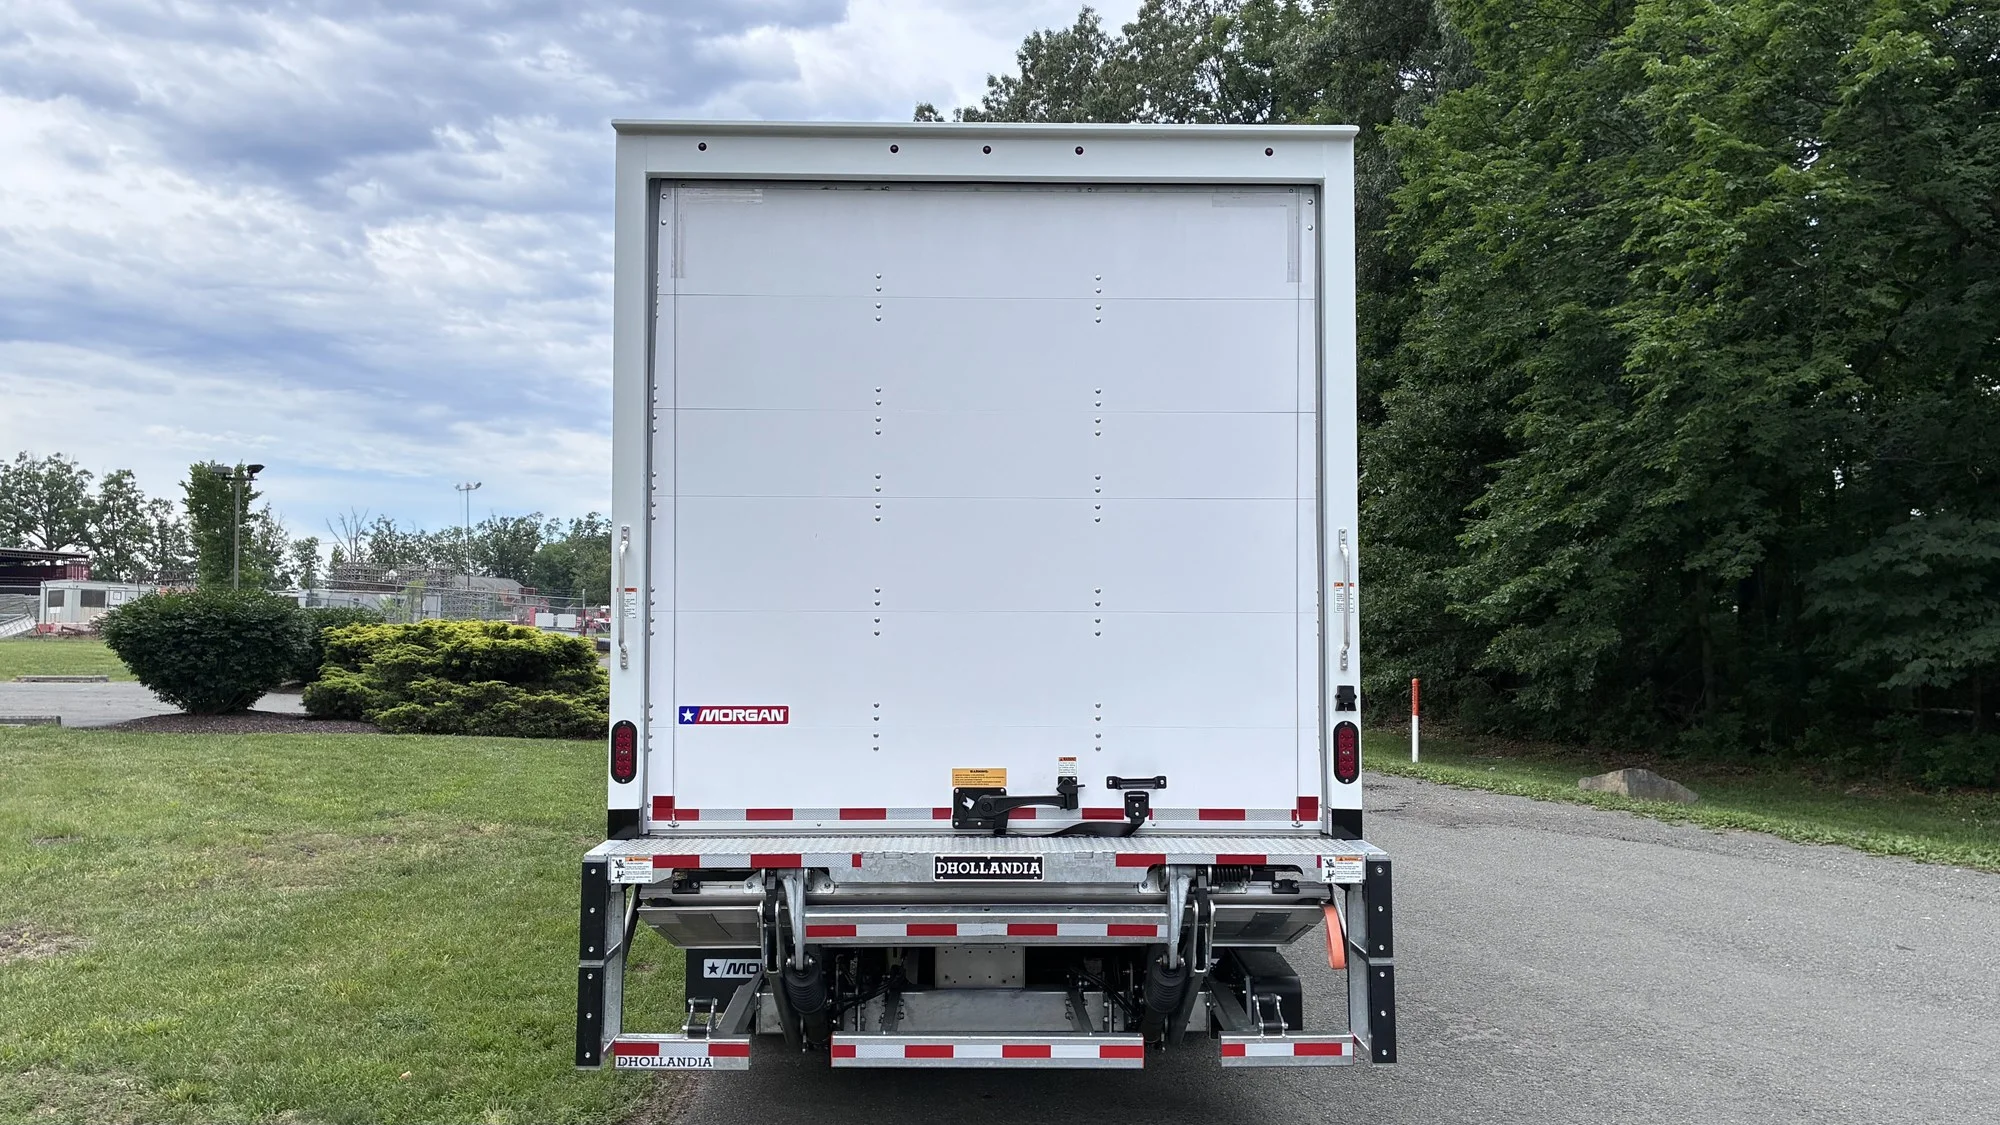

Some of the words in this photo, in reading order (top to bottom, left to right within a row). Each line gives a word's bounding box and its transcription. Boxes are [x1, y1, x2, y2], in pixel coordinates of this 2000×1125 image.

[699, 709, 784, 722] MORGAN
[936, 862, 1041, 874] DHOLLANDIA
[726, 963, 763, 975] MO
[617, 1056, 712, 1067] DHOLLANDIA
